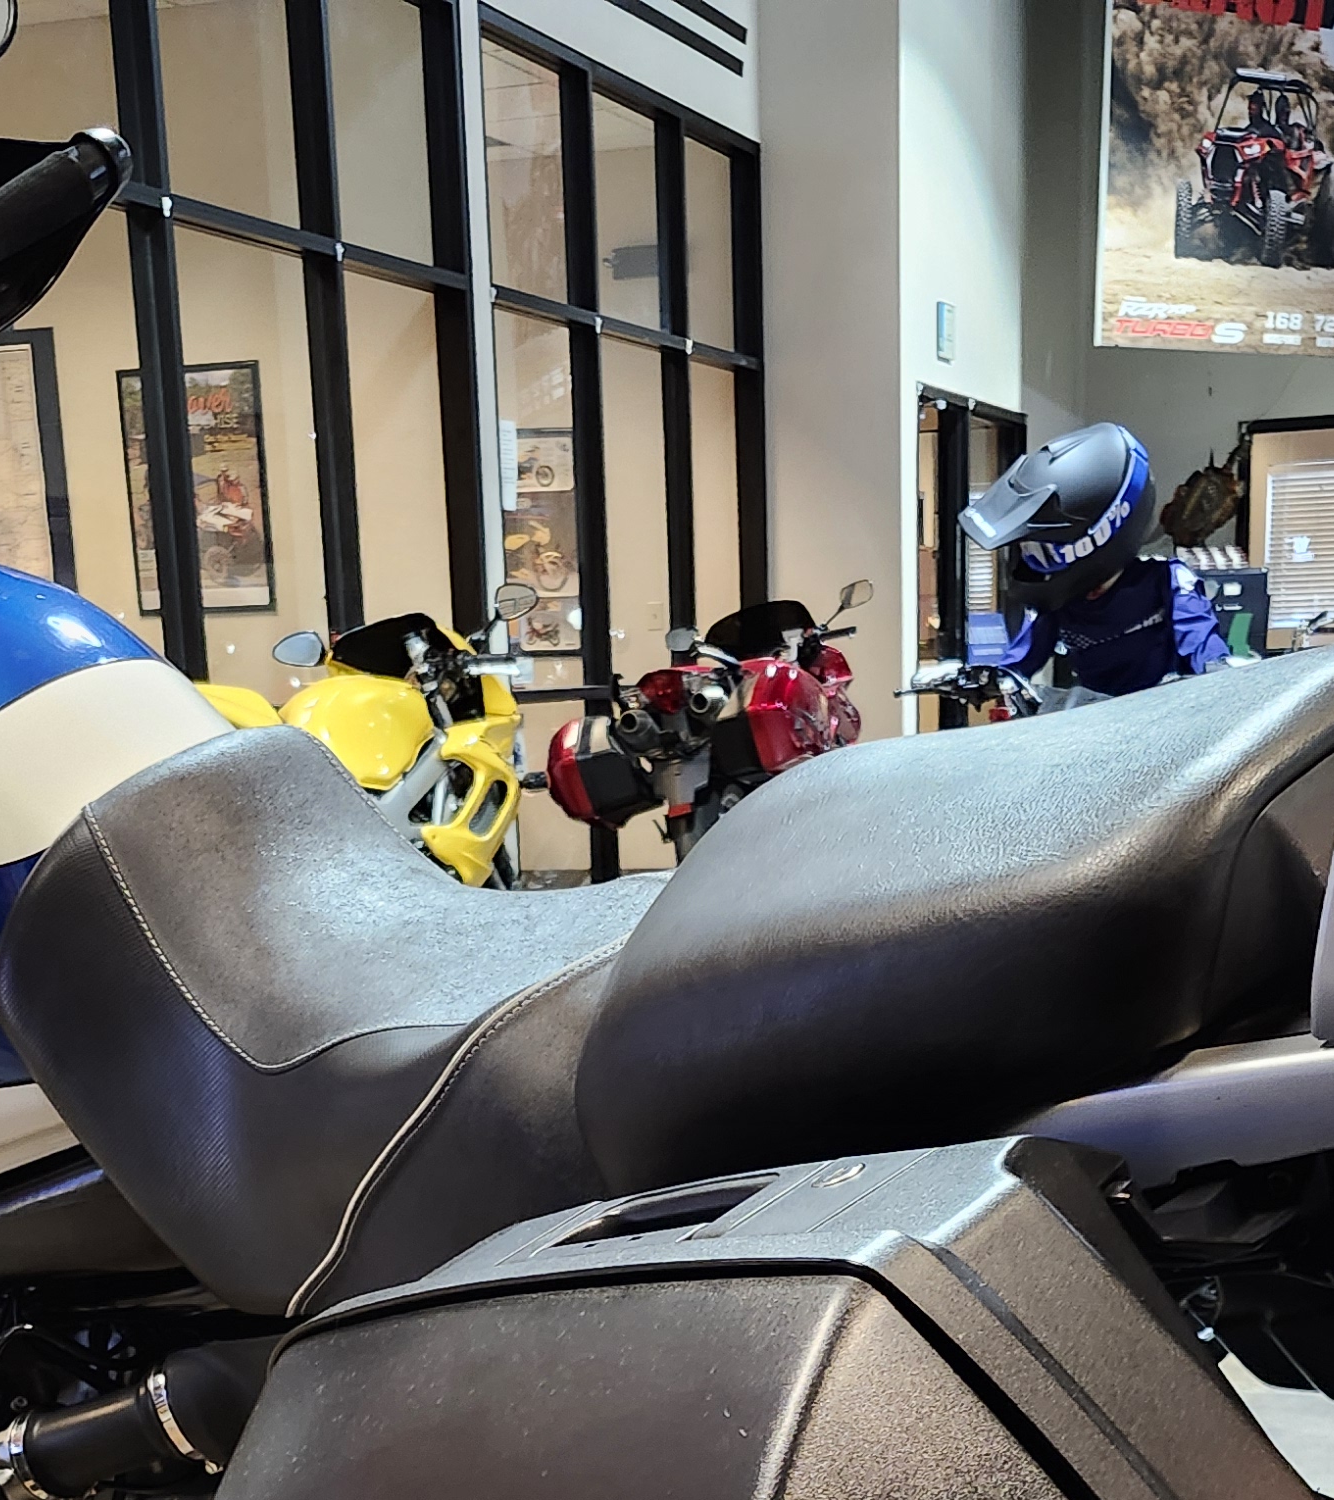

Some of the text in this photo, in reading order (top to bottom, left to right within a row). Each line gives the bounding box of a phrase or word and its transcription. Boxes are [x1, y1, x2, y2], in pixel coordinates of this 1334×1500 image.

[1114, 318, 1214, 340] TURBO
[1211, 322, 1249, 345] S
[1263, 310, 1303, 331] 168
[1059, 500, 1131, 564] 100%
